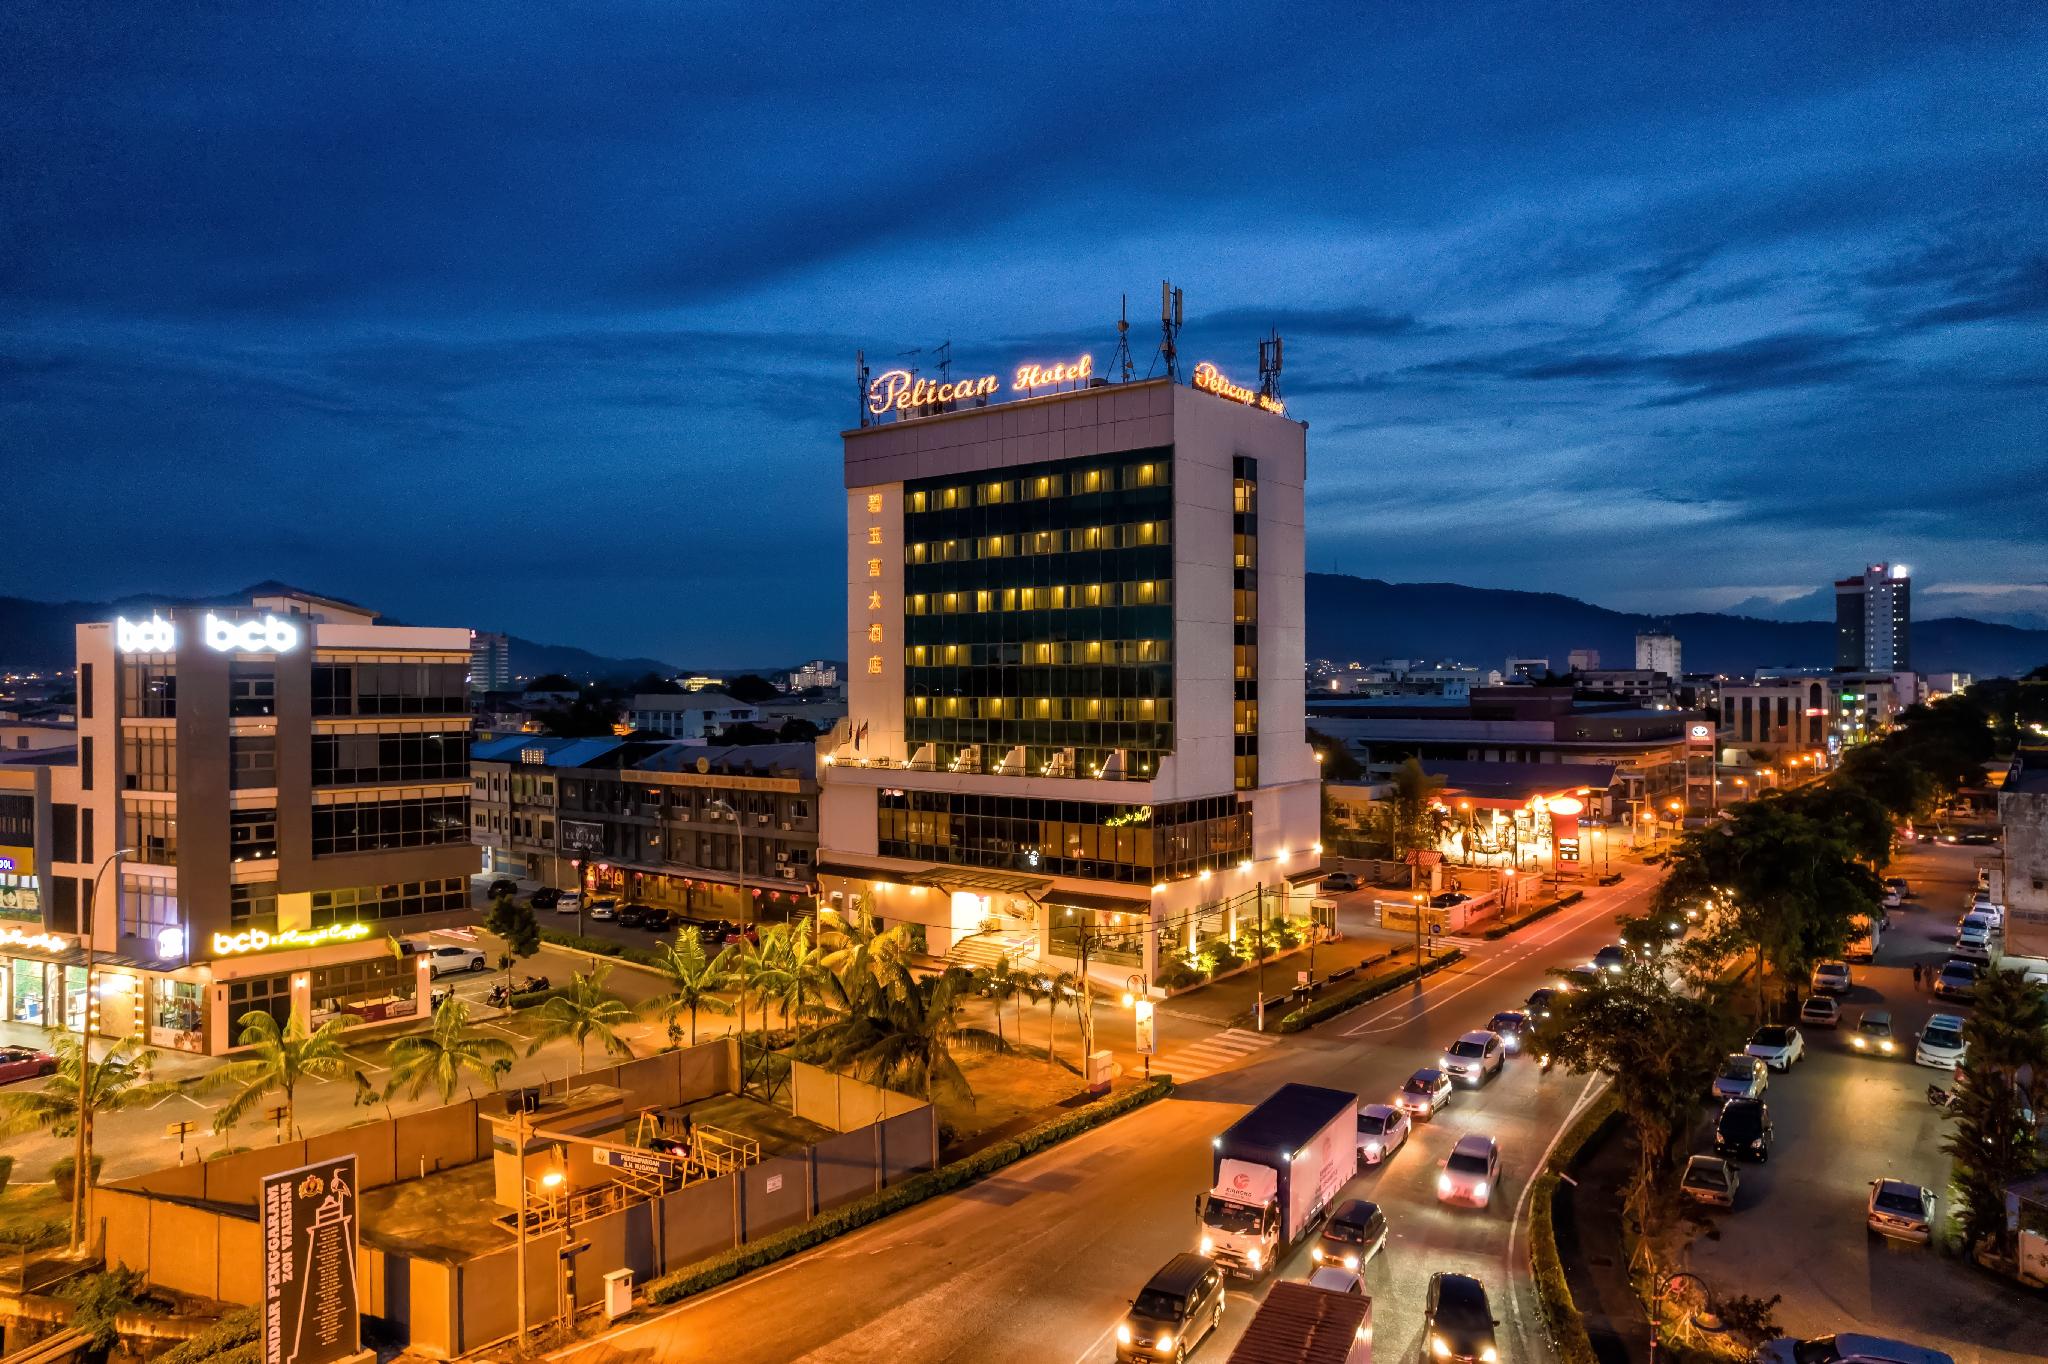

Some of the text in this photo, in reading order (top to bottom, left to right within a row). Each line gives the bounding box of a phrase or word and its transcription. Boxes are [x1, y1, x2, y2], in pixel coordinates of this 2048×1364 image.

[870, 354, 1093, 414] Pelican Hotel
[1195, 362, 1285, 414] Pelican Hotel
[117, 614, 176, 654] bcb
[205, 612, 298, 653] bcb
[213, 928, 270, 955] bcb
[267, 1184, 281, 1299] PENGGARAM
[280, 1181, 294, 1283] ZON WARISAN
